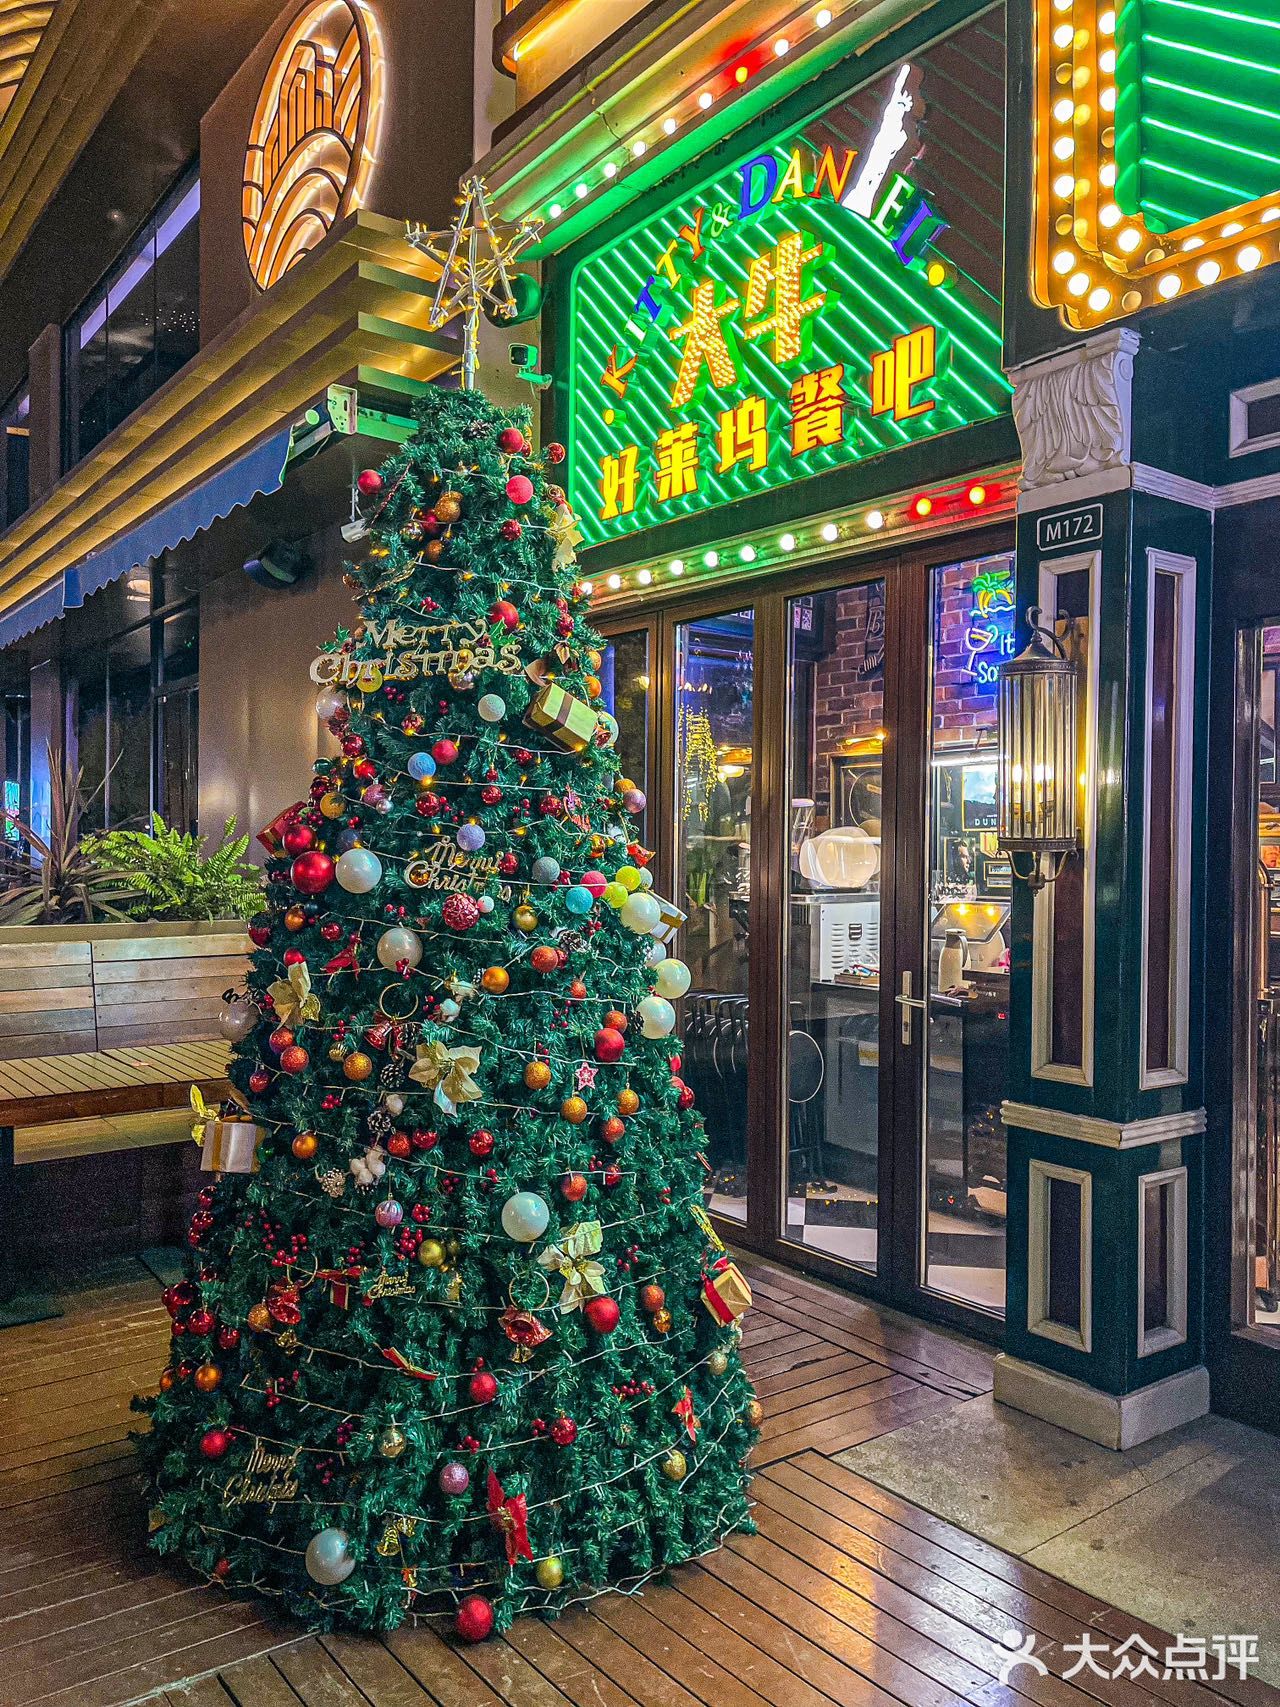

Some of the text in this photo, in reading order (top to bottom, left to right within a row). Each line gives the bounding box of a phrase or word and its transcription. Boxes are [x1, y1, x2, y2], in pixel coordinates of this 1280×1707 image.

[601, 206, 705, 399] KITTY
[710, 202, 734, 239] &
[669, 231, 827, 408] 大牛
[600, 325, 936, 520] 好莱坞餐吧
[1045, 514, 1094, 542] M172
[309, 643, 523, 689] Christmas
[361, 618, 487, 652] Merry
